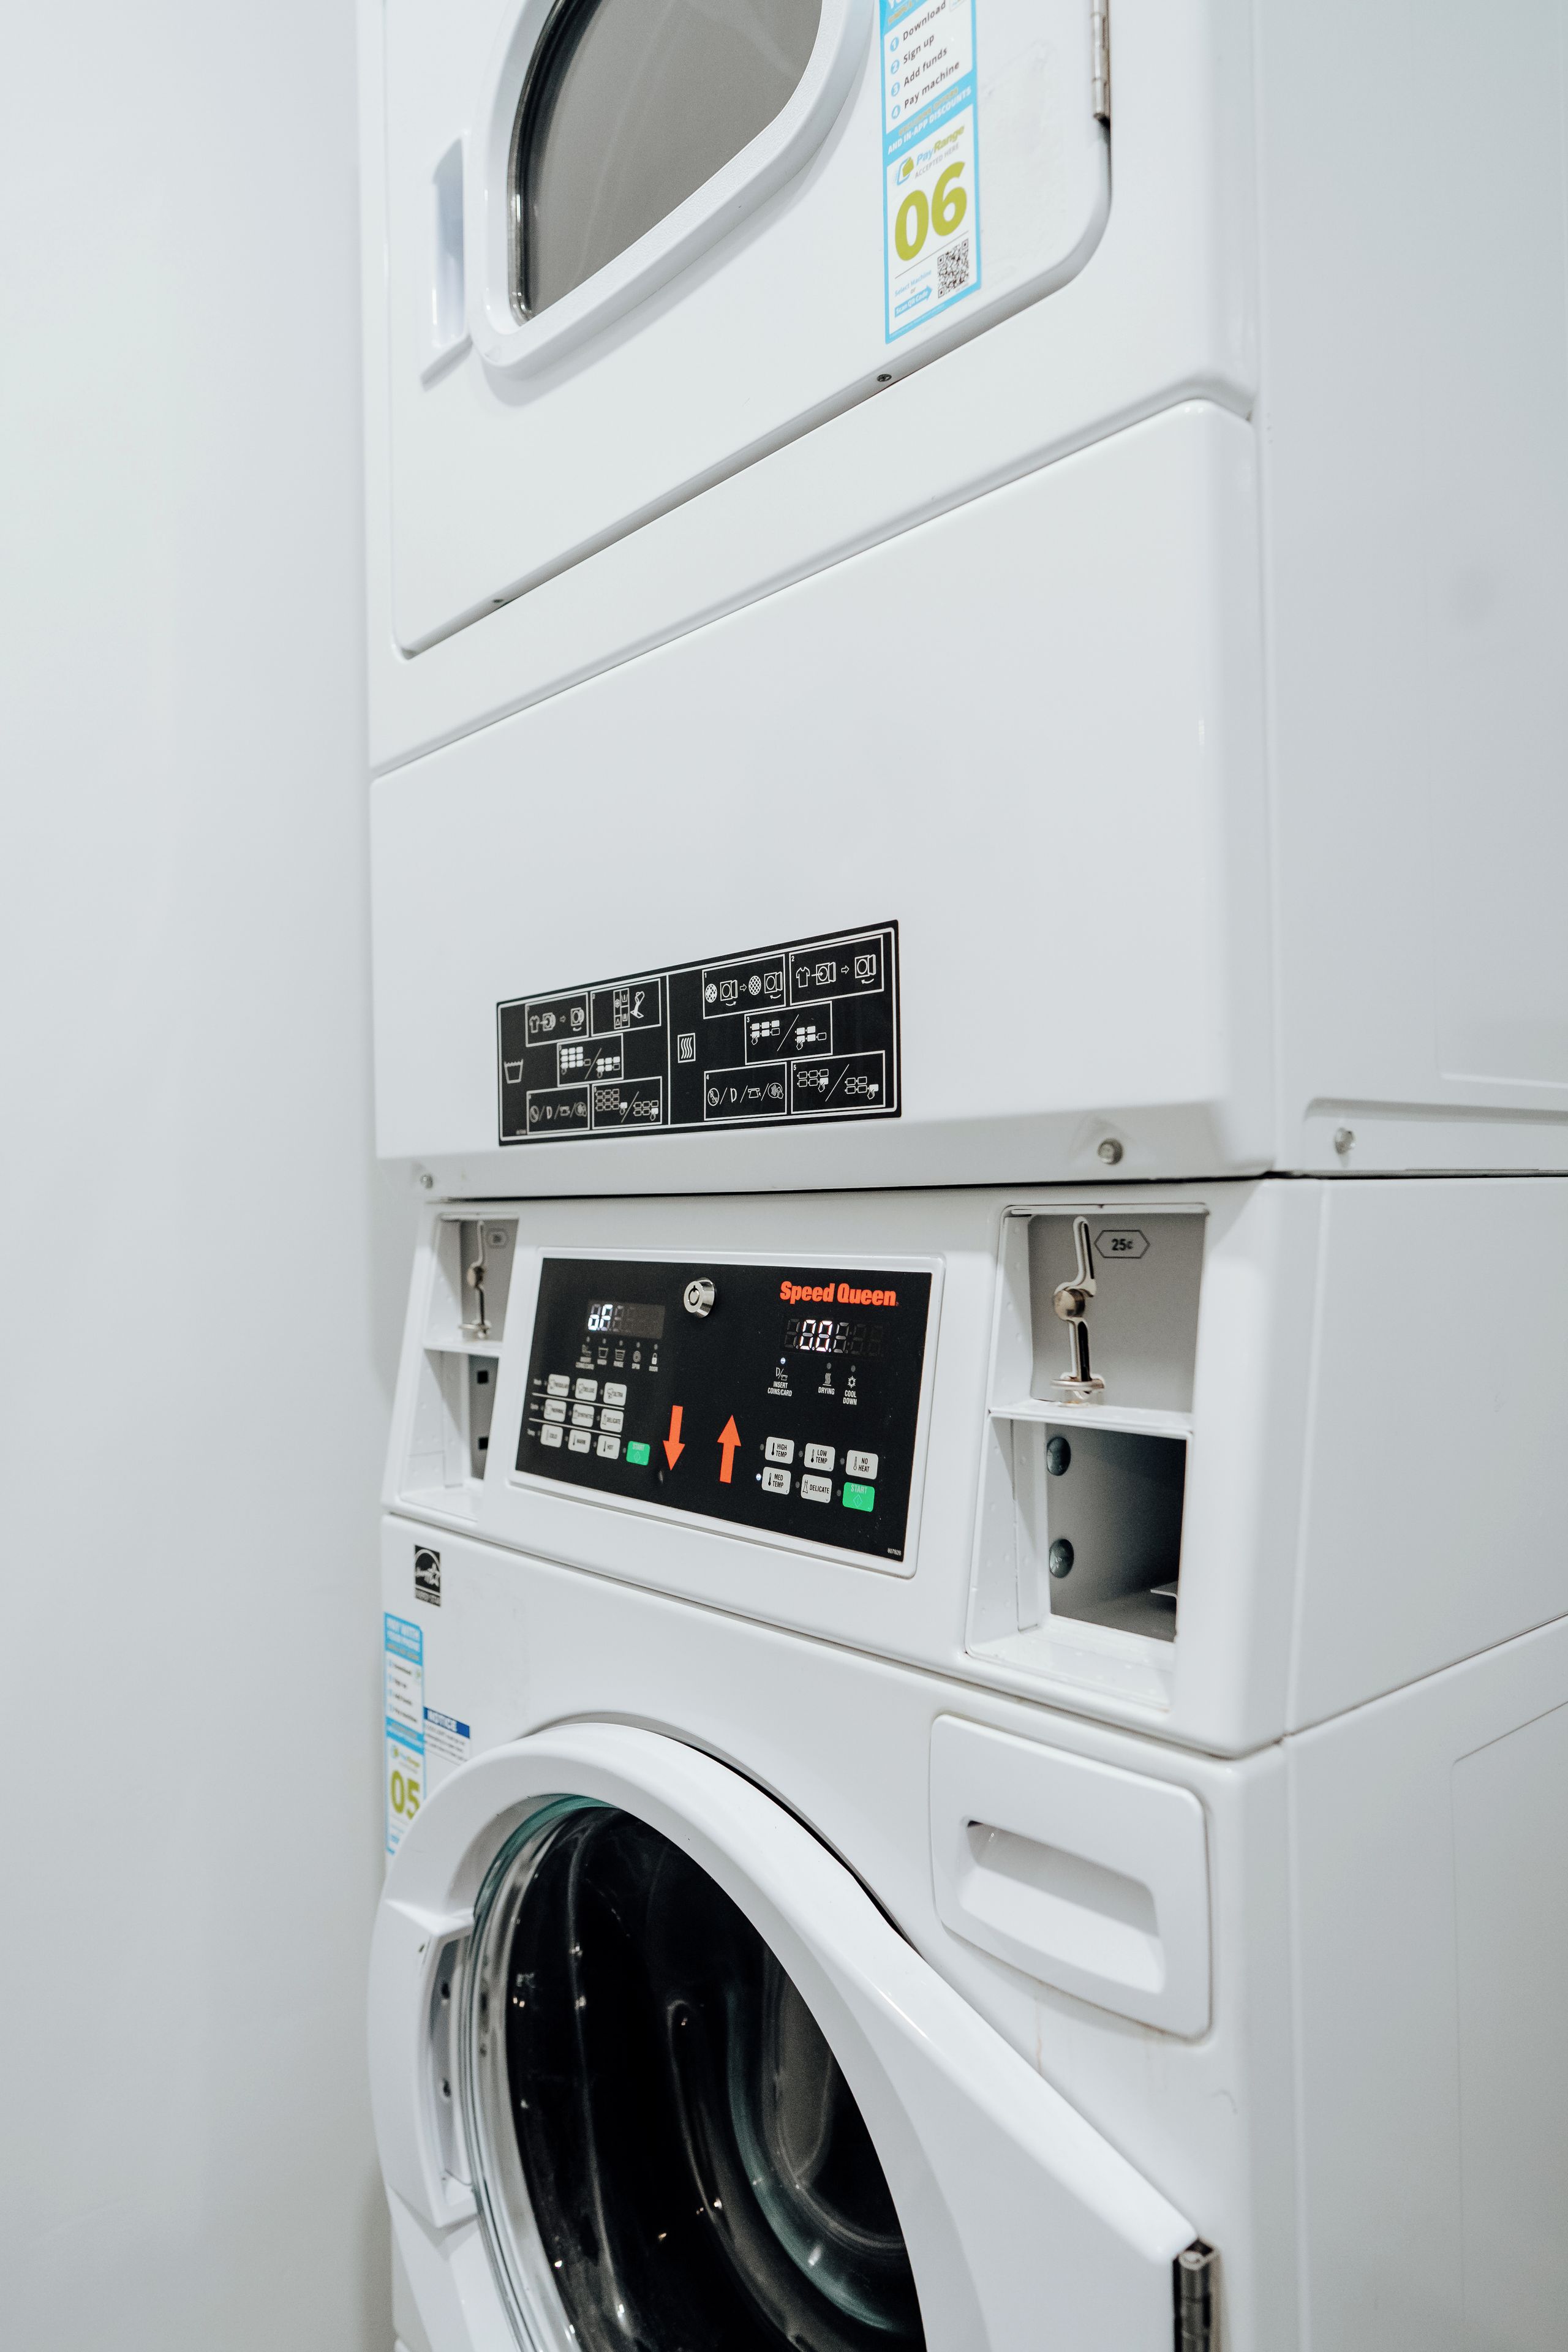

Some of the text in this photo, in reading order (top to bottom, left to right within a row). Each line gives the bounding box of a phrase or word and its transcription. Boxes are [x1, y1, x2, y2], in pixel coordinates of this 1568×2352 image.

[903, 0, 946, 40] Download
[903, 45, 921, 64] Sign
[924, 35, 935, 48] up
[904, 67, 920, 87] Add
[923, 47, 948, 72] funds
[904, 92, 919, 109] Pay
[922, 61, 960, 96] machine
[888, 138, 902, 155] AND
[903, 118, 928, 143] IN-APP
[929, 86, 972, 124] DISCOUNTS
[915, 143, 959, 179] ACCEPTED HERE
[916, 124, 965, 166] PayRange
[895, 161, 968, 262] 06
[780, 1281, 897, 1306] Speed Queen
[767, 1387, 793, 1396] COINS/CARD
[818, 1386, 835, 1395] DRYING
[809, 1483, 830, 1494] DELICATE
[851, 1484, 869, 1494] START
[391, 1770, 420, 1820] 05
